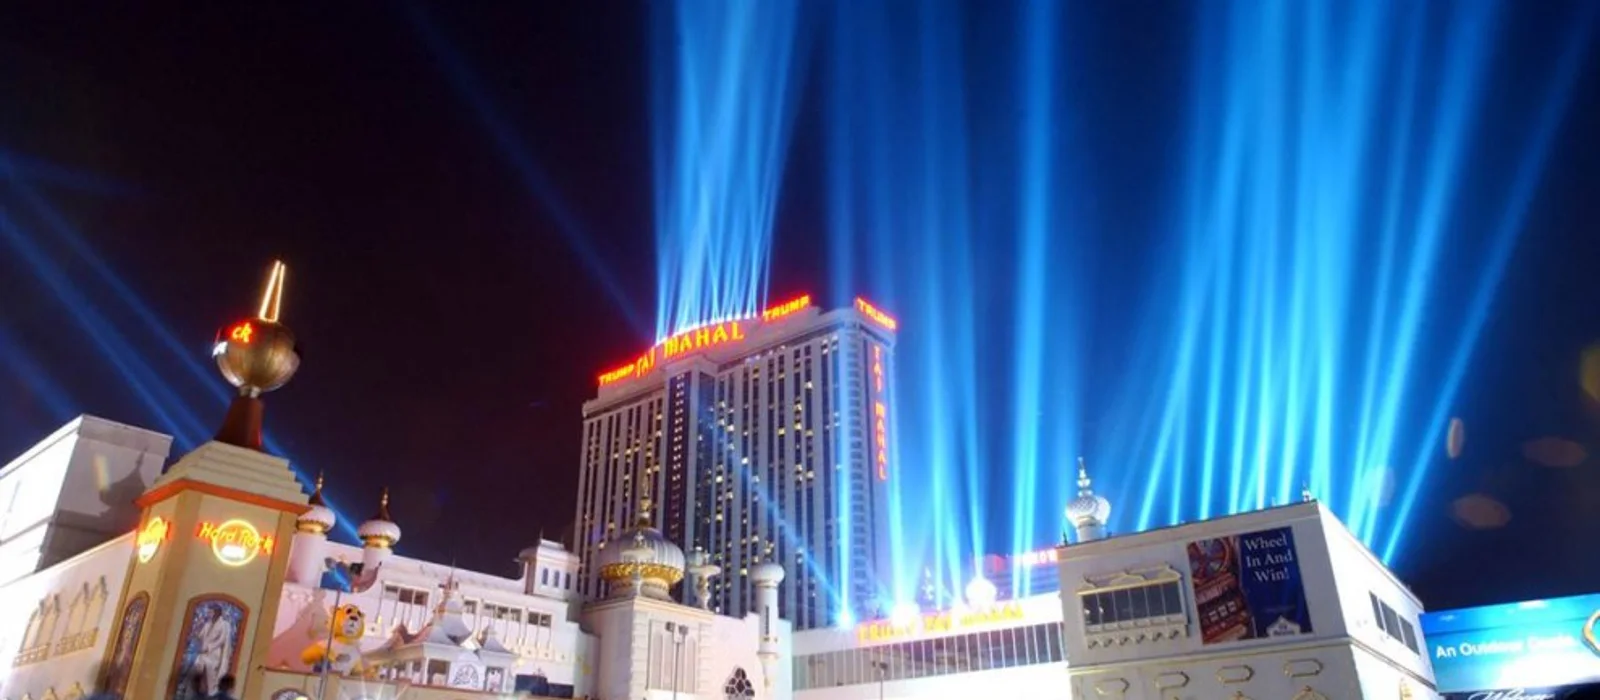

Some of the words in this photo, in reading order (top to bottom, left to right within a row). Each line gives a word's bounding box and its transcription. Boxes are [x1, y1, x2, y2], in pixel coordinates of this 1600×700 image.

[763, 294, 810, 322] TRUMP
[856, 296, 897, 330] TRUMP
[636, 346, 656, 378] TAJ
[663, 320, 745, 359] MAHAL
[598, 364, 635, 387] TRUMP
[873, 344, 882, 393] TAJ
[875, 401, 886, 481] MAHAL
[199, 521, 237, 542] Hard
[240, 527, 274, 556] Rock
[1243, 532, 1288, 551] Wheel
[1246, 555, 1261, 568] In
[1264, 548, 1293, 565] And
[1254, 566, 1290, 582] Win!
[1436, 645, 1457, 659] An
